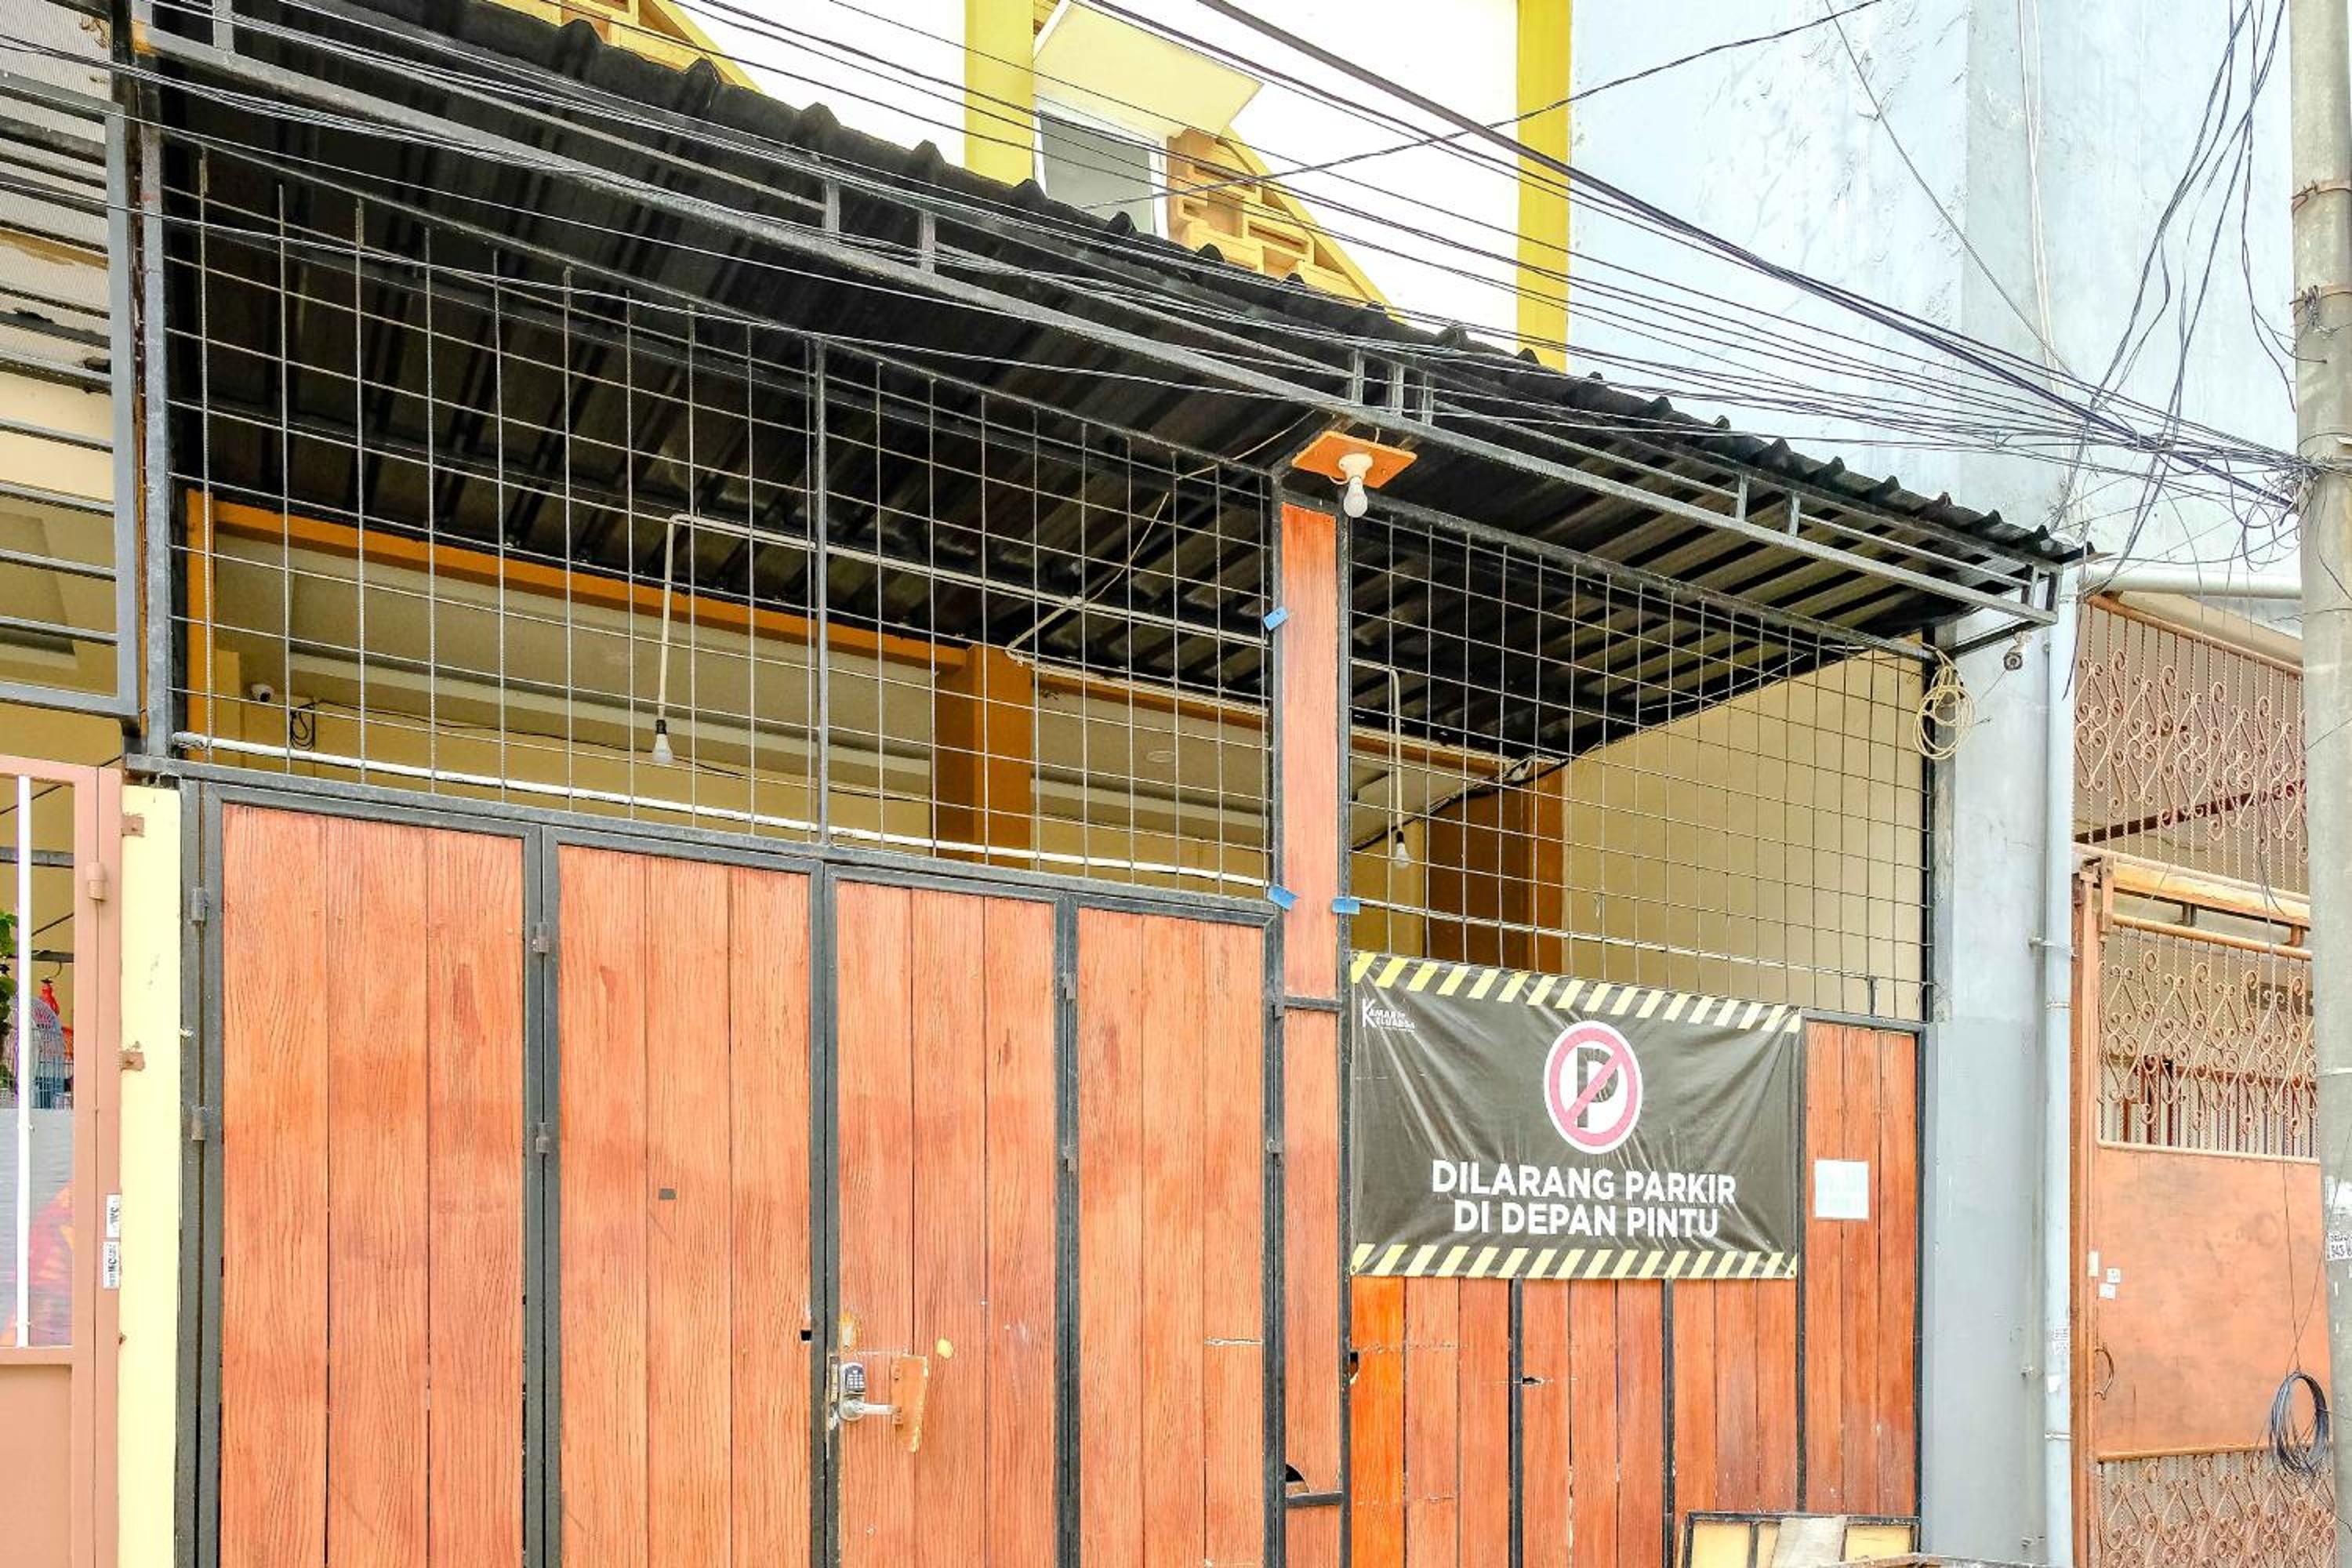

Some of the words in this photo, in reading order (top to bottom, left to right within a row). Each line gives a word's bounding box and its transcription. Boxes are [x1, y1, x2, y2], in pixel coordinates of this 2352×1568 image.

[1432, 1160, 1614, 1200] DILARANG
[1625, 1170, 1736, 1204] PARKIR
[1454, 1199, 1490, 1233] DI
[1501, 1202, 1616, 1236] DEPAN
[1627, 1207, 1719, 1239] PINTU
